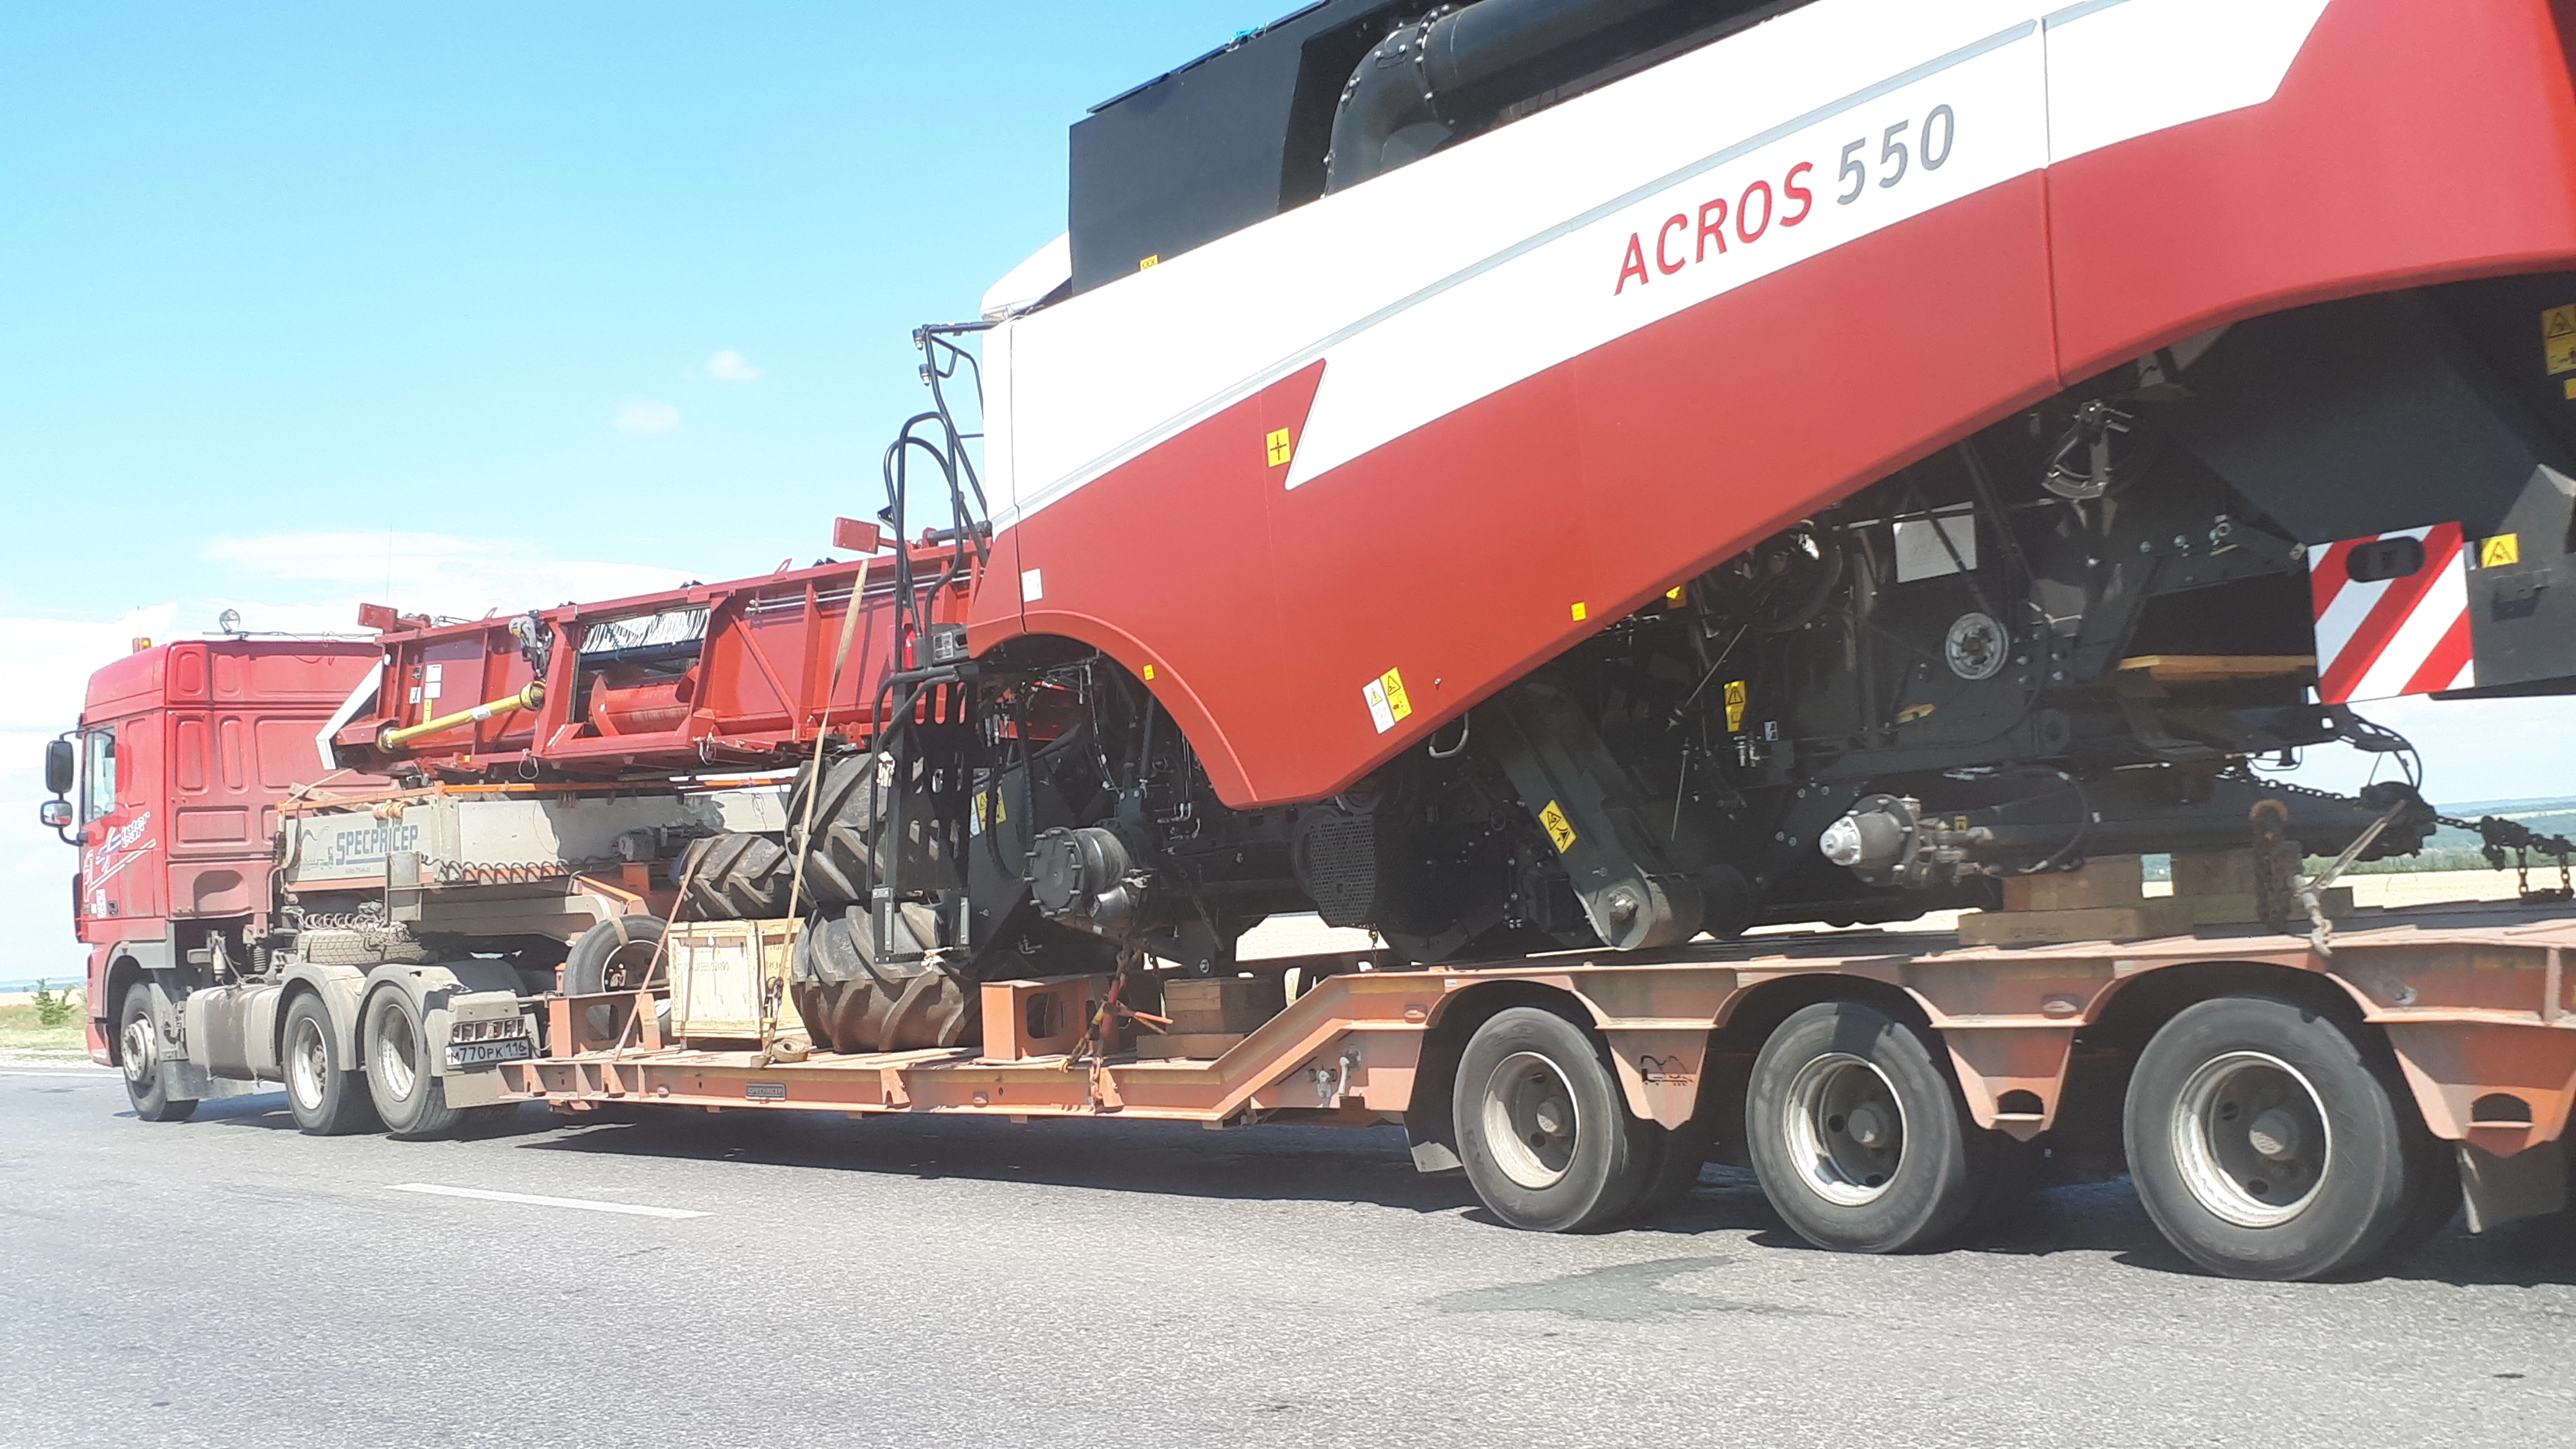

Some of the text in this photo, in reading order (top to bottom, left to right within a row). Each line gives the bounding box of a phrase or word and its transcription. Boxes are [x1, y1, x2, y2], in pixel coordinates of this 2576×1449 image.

[1613, 103, 1955, 296] ACROS 550
[336, 825, 419, 865] SPECPRICEP
[505, 1041, 527, 1053] 116
